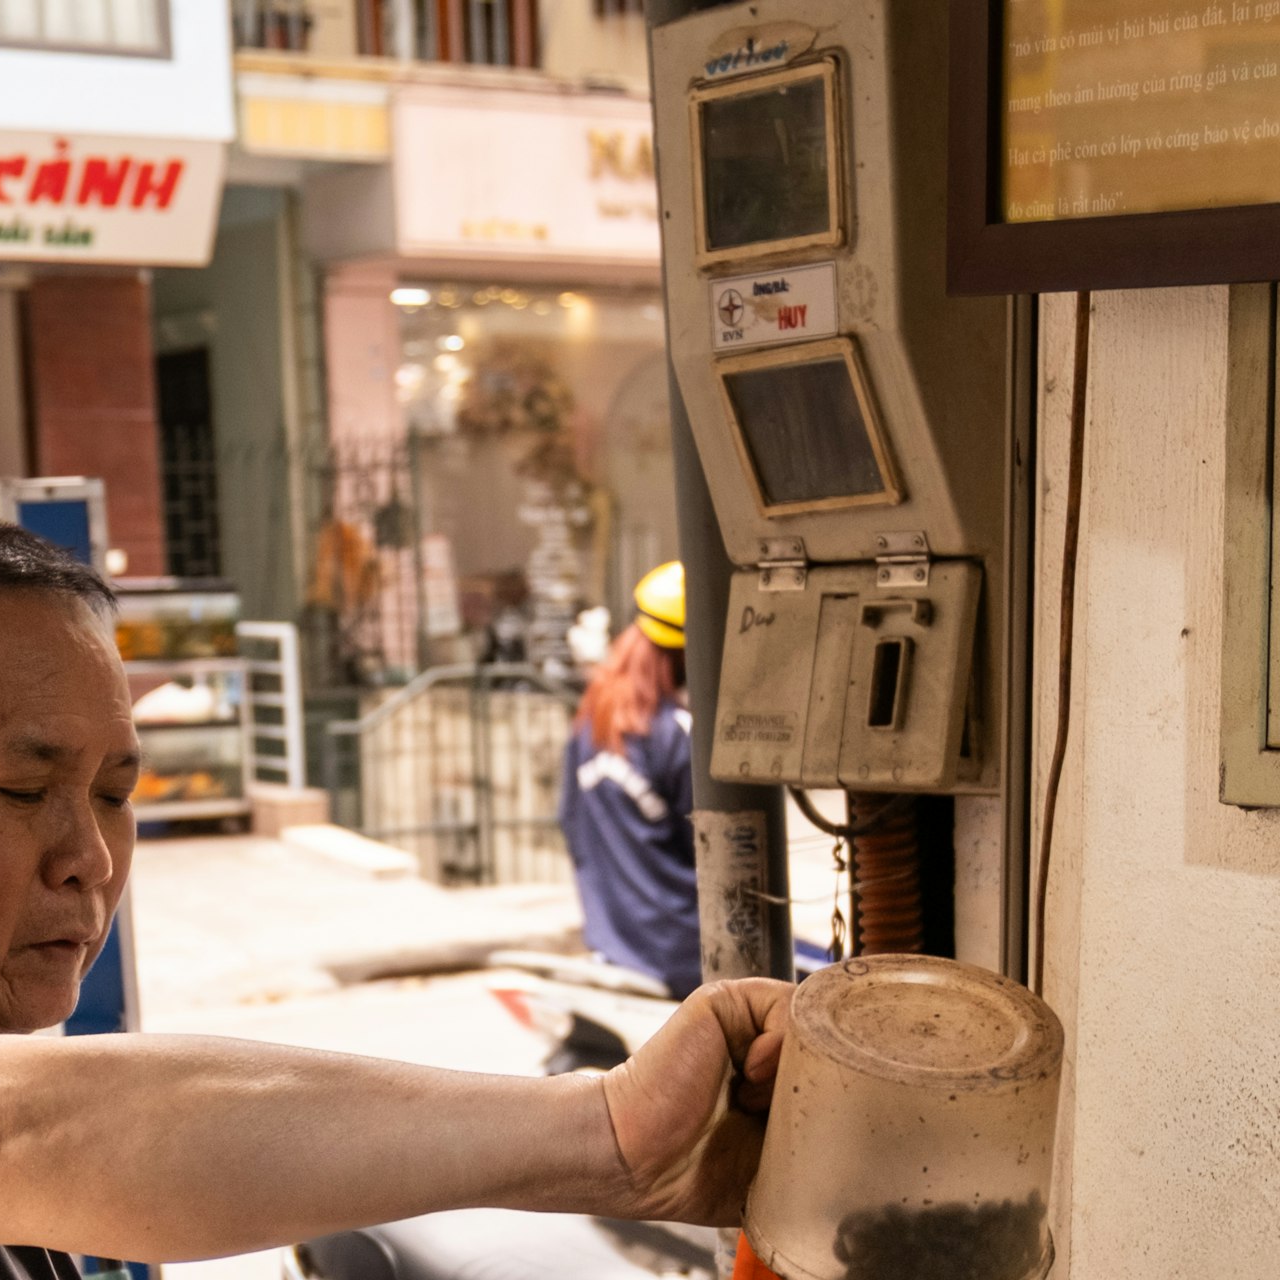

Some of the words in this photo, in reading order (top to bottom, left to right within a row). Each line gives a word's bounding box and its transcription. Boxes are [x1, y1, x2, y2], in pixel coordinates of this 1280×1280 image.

[1174, 11, 1198, 31] của
[1008, 95, 1041, 114] mang
[1045, 89, 1071, 108] theo
[1142, 74, 1166, 96] của
[1170, 71, 1202, 93] rừng
[1254, 58, 1277, 79] của
[1050, 142, 1072, 167] phê
[1102, 137, 1117, 156] có
[1166, 128, 1199, 151] cứng
[1233, 120, 1250, 145] vệ
[1254, 117, 1279, 139] cho
[1025, 201, 1055, 221] cũng
[1058, 196, 1069, 215] là
[777, 304, 808, 331] HUY
[722, 329, 744, 342] EVN
